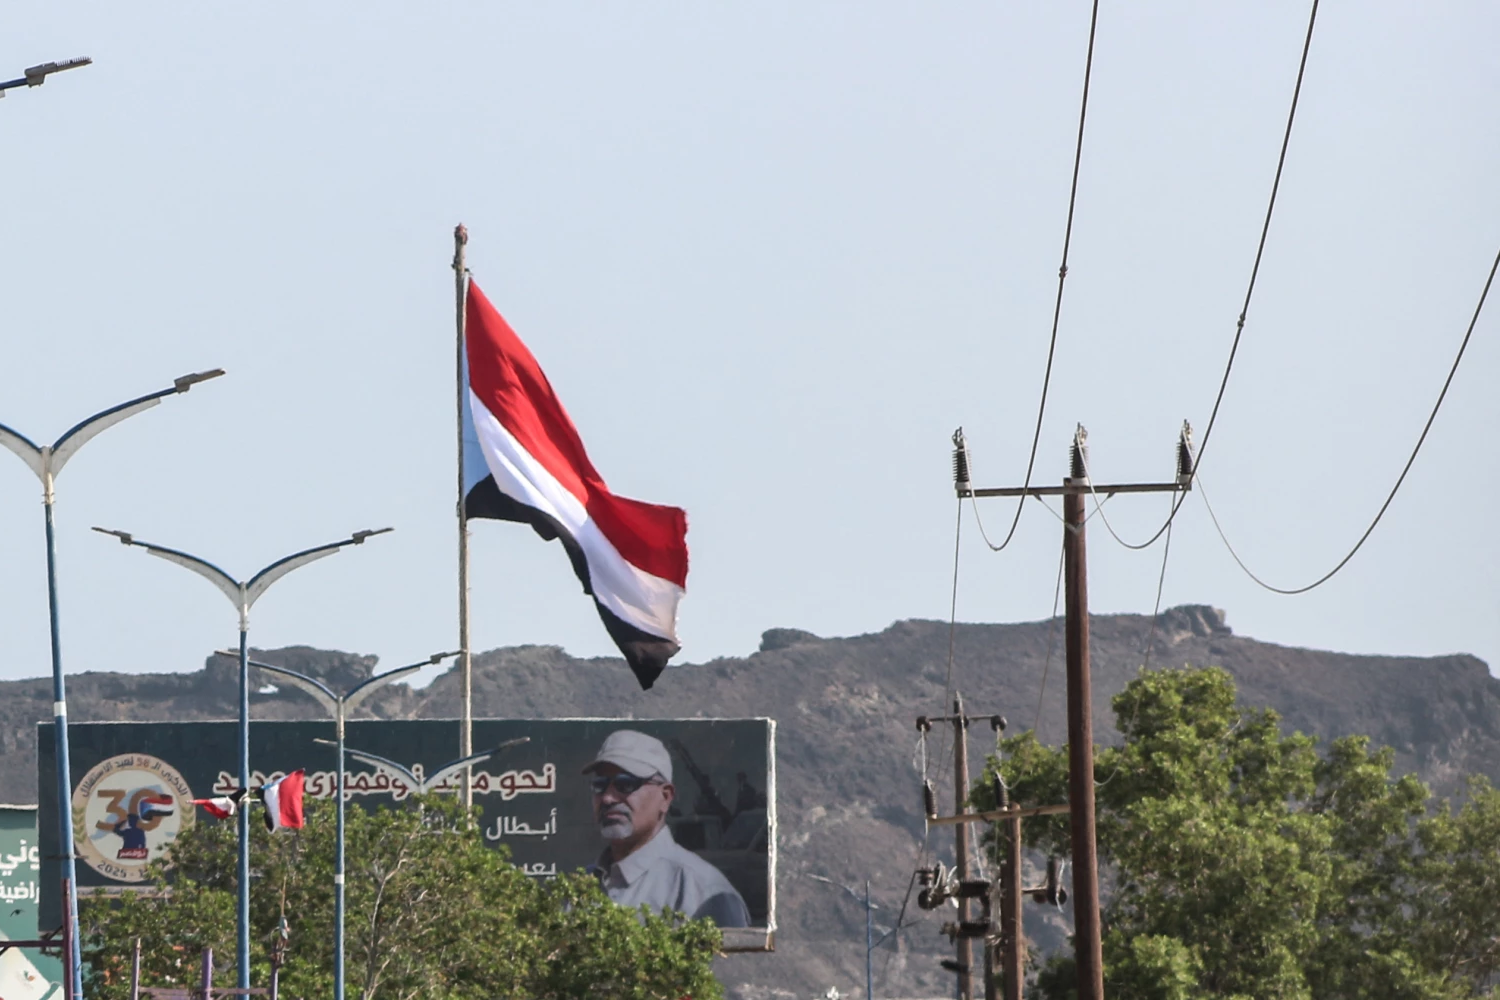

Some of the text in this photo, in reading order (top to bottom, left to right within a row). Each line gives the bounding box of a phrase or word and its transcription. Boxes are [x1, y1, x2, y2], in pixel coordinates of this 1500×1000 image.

[137, 757, 149, 768] 58
[500, 763, 556, 800] نحو
[486, 807, 557, 841] أبطال
[97, 861, 127, 878] 2025
